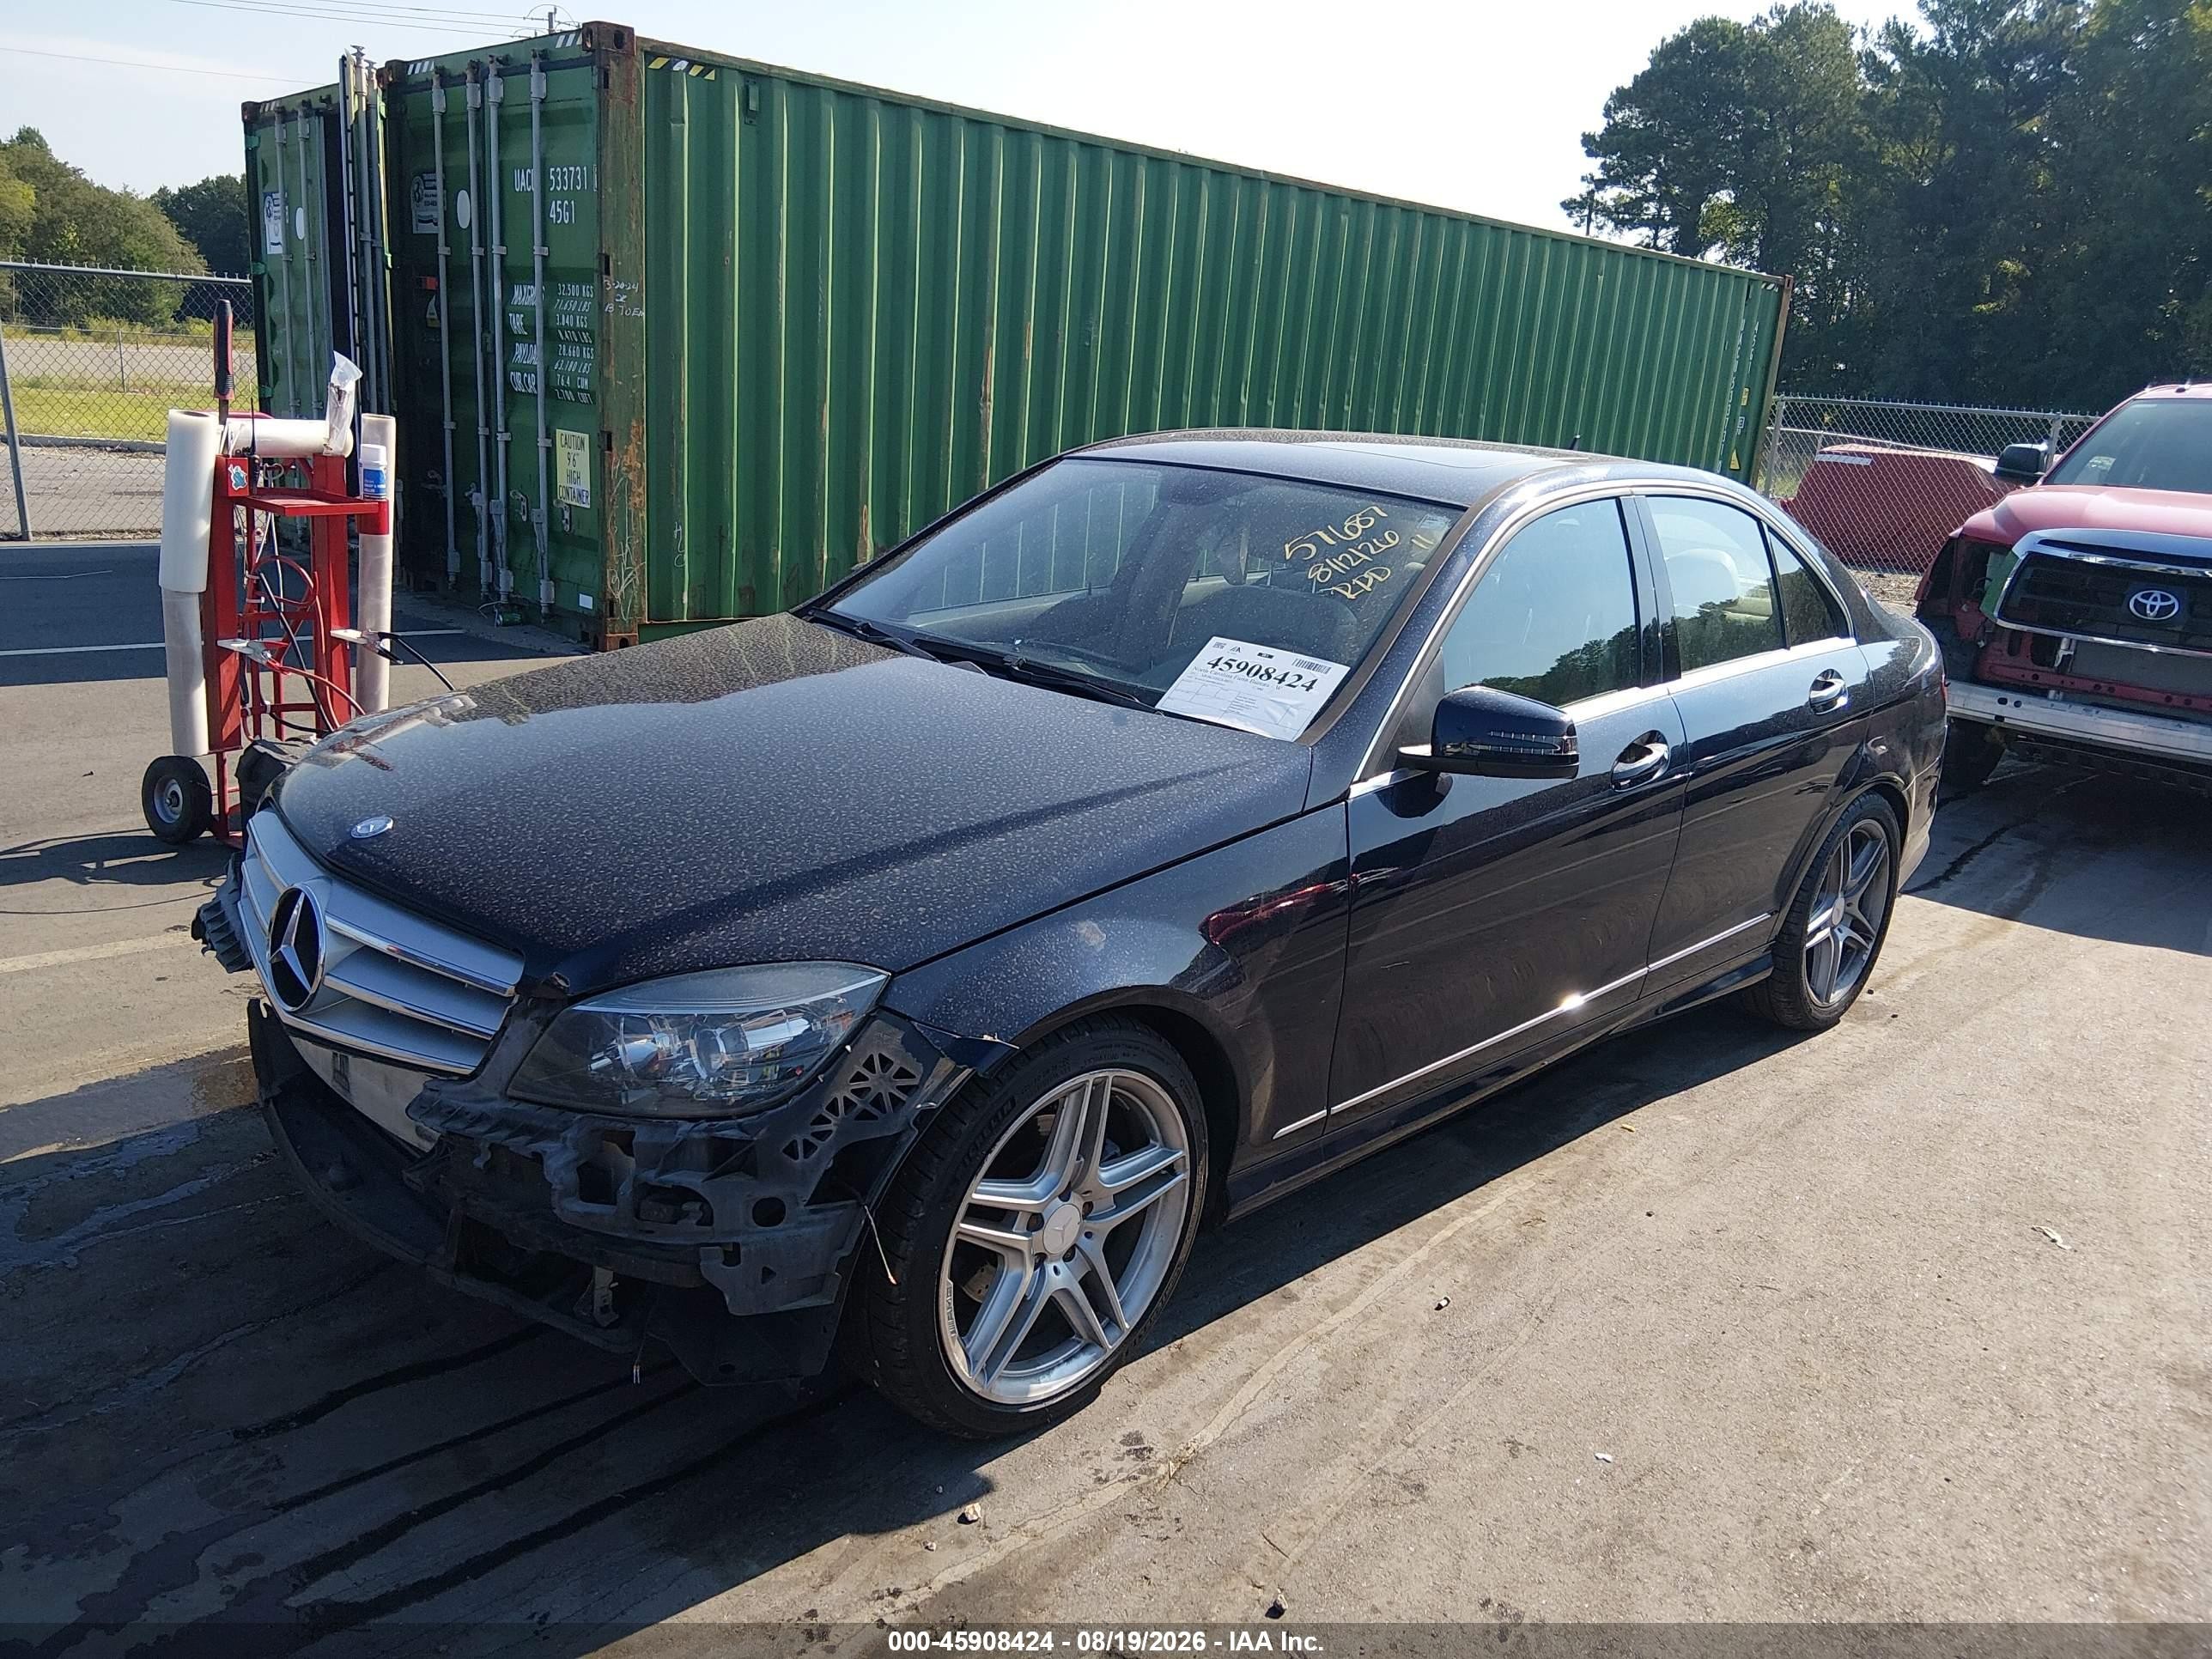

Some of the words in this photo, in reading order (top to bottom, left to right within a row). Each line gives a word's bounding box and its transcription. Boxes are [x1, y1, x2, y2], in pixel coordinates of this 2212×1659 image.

[550, 166, 587, 191] 533731
[550, 199, 574, 223] 45G1
[582, 285, 594, 298] KGS
[578, 301, 592, 313] LBS
[508, 313, 528, 335] TARE
[576, 315, 588, 329] KGS
[512, 343, 538, 365] PAYLOA
[582, 346, 594, 359] KGS
[578, 362, 592, 374] LBS
[560, 433, 586, 453] CAUTION
[566, 468, 581, 486] HIGH
[558, 484, 590, 506] CONTAINER
[1207, 655, 1319, 692] 45908424
